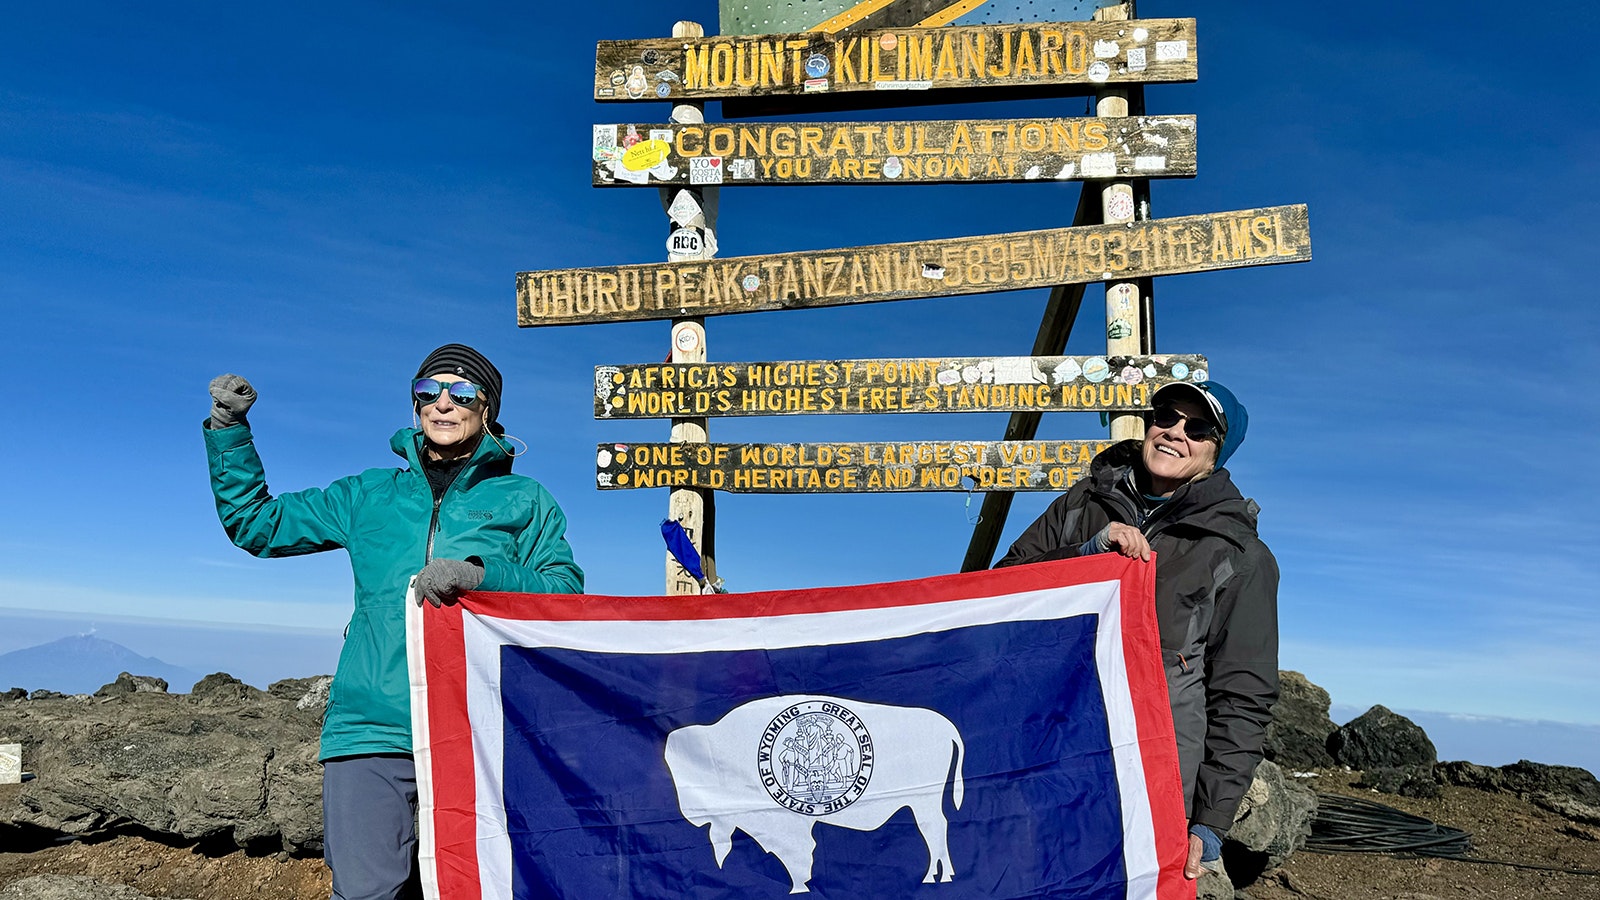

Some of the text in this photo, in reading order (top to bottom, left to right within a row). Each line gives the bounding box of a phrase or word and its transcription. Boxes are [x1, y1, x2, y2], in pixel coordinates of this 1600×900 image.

[685, 30, 1087, 90] MOUNT KILIMANJARO
[675, 122, 1110, 158] CONGRATULATIONS
[692, 159, 709, 168] YO
[761, 157, 1020, 179] YOU ARE NOW AT
[692, 175, 721, 183] RICA
[529, 269, 641, 318] UHURU
[1211, 213, 1298, 262] AMSL
[629, 361, 941, 389] AFRICA'S HIGHEST POINT
[628, 390, 733, 414] WORLD'S
[741, 387, 851, 411] HIGHEST
[1062, 384, 1161, 407] MOUNT
[634, 446, 685, 466] ONE
[697, 447, 730, 466] OF
[863, 445, 988, 465] LARGEST
[634, 469, 725, 488] WORLD
[734, 468, 858, 489] HERITAGE
[867, 469, 914, 488] AND
[1048, 467, 1082, 488] OF
[821, 703, 864, 733] GREAT
[760, 706, 800, 763] WYOMING
[859, 733, 872, 771] SEAL
[761, 767, 776, 787] OF
[852, 775, 868, 796] OF
[772, 788, 816, 813] STATE
[823, 796, 852, 813] THE
